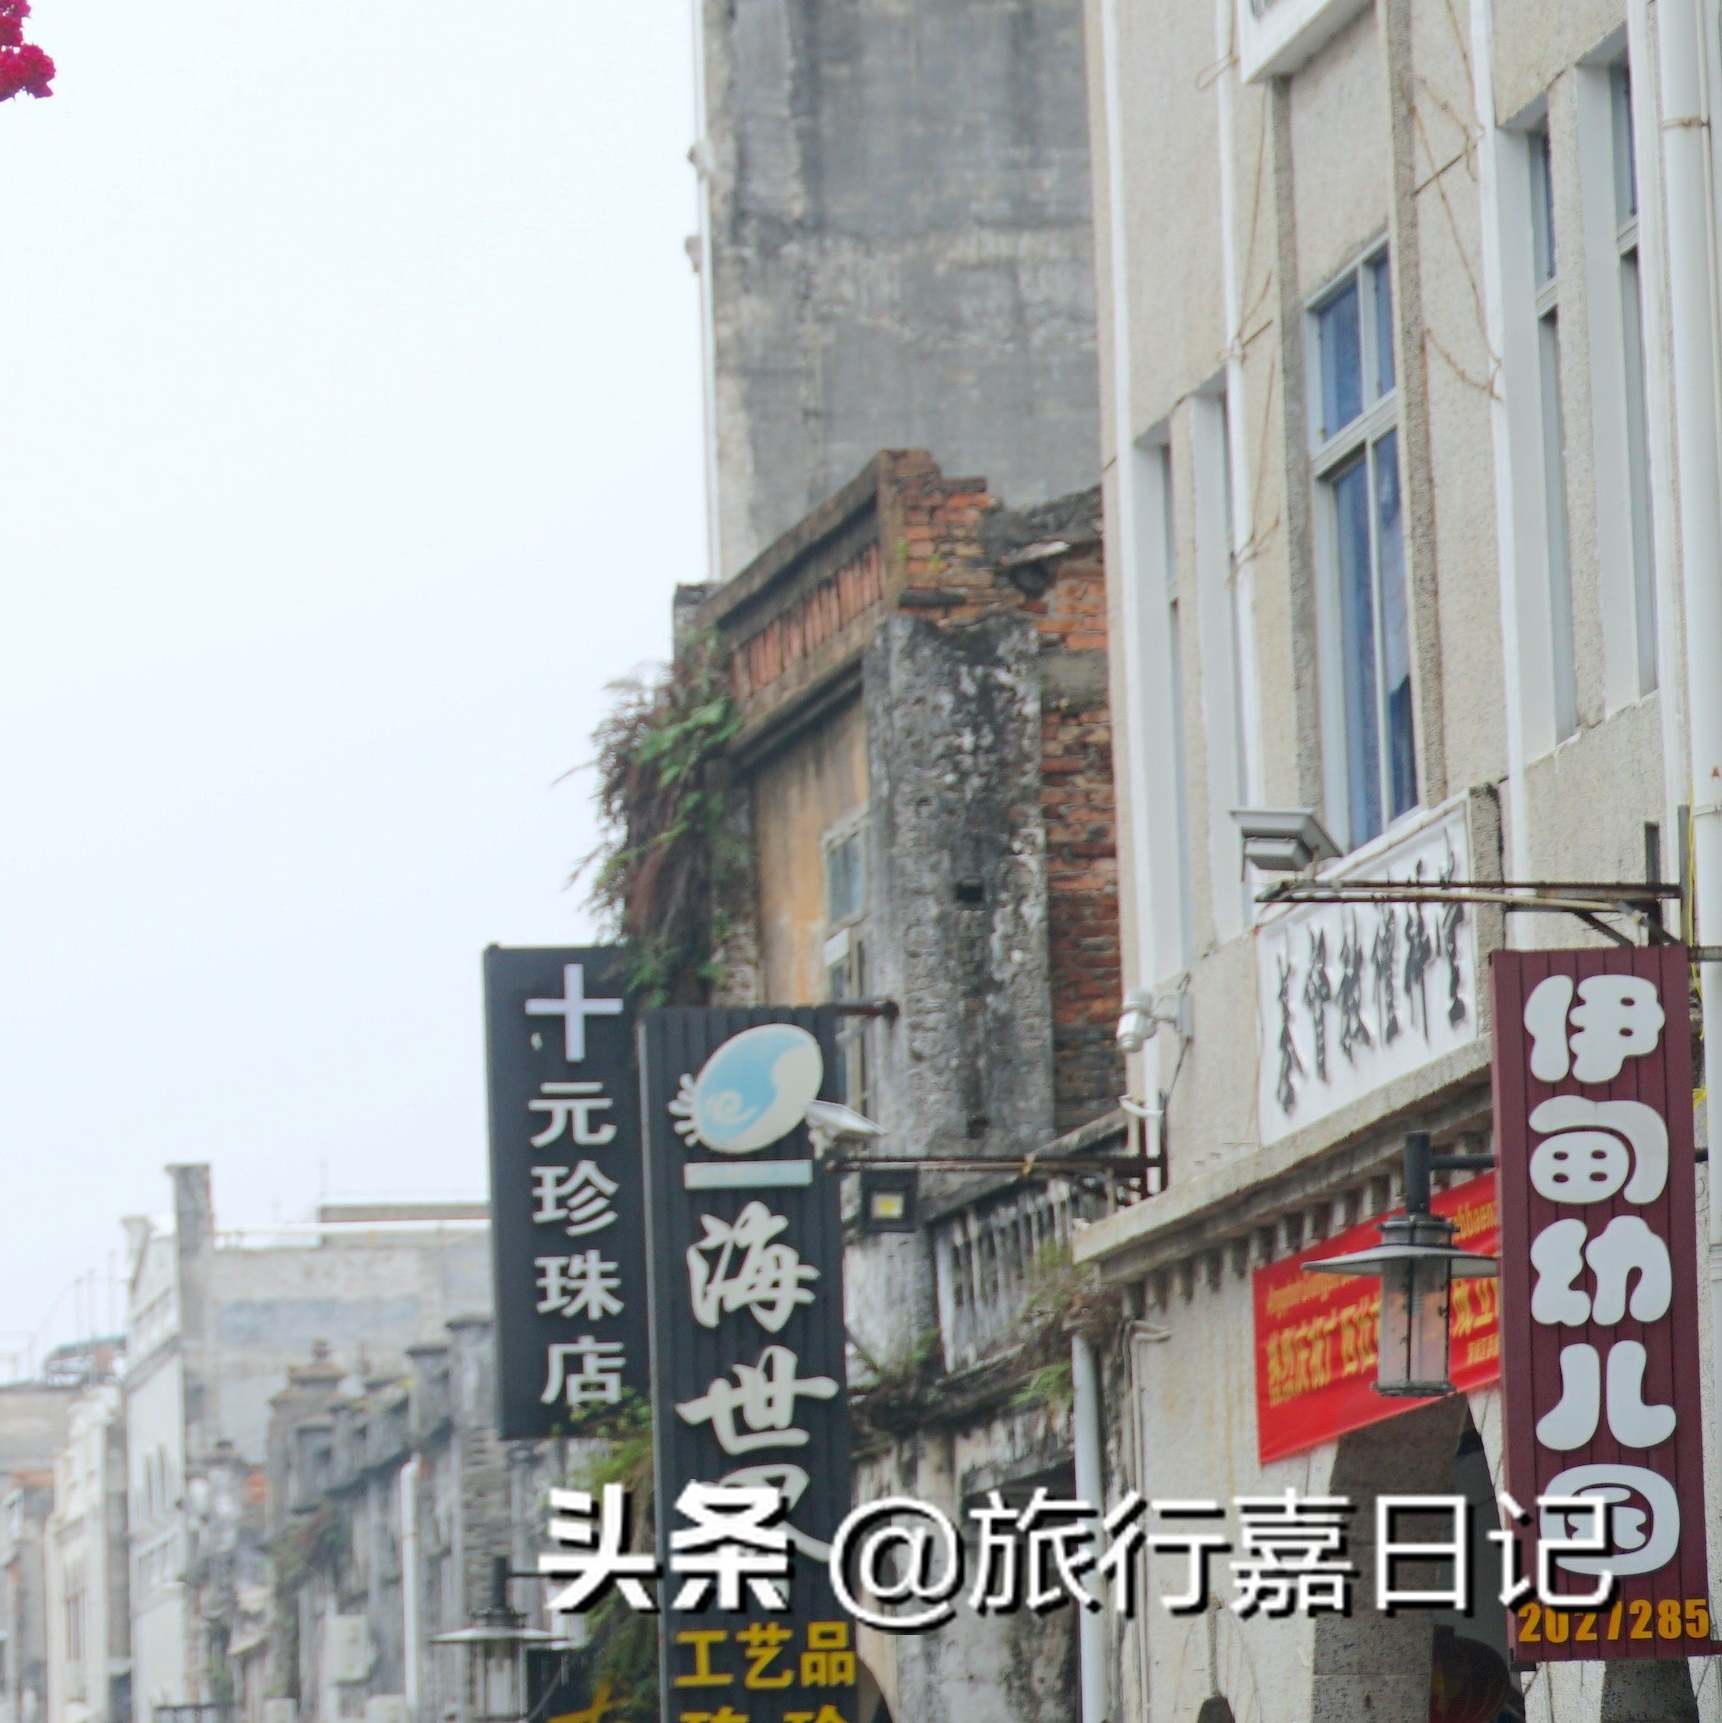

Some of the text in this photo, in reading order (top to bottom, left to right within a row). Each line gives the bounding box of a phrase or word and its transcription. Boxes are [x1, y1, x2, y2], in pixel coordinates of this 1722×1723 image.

[525, 962, 626, 1406] 十元珍珠店
[674, 1621, 857, 1689] 工艺品
[1518, 1599, 1709, 1643] 2027285
